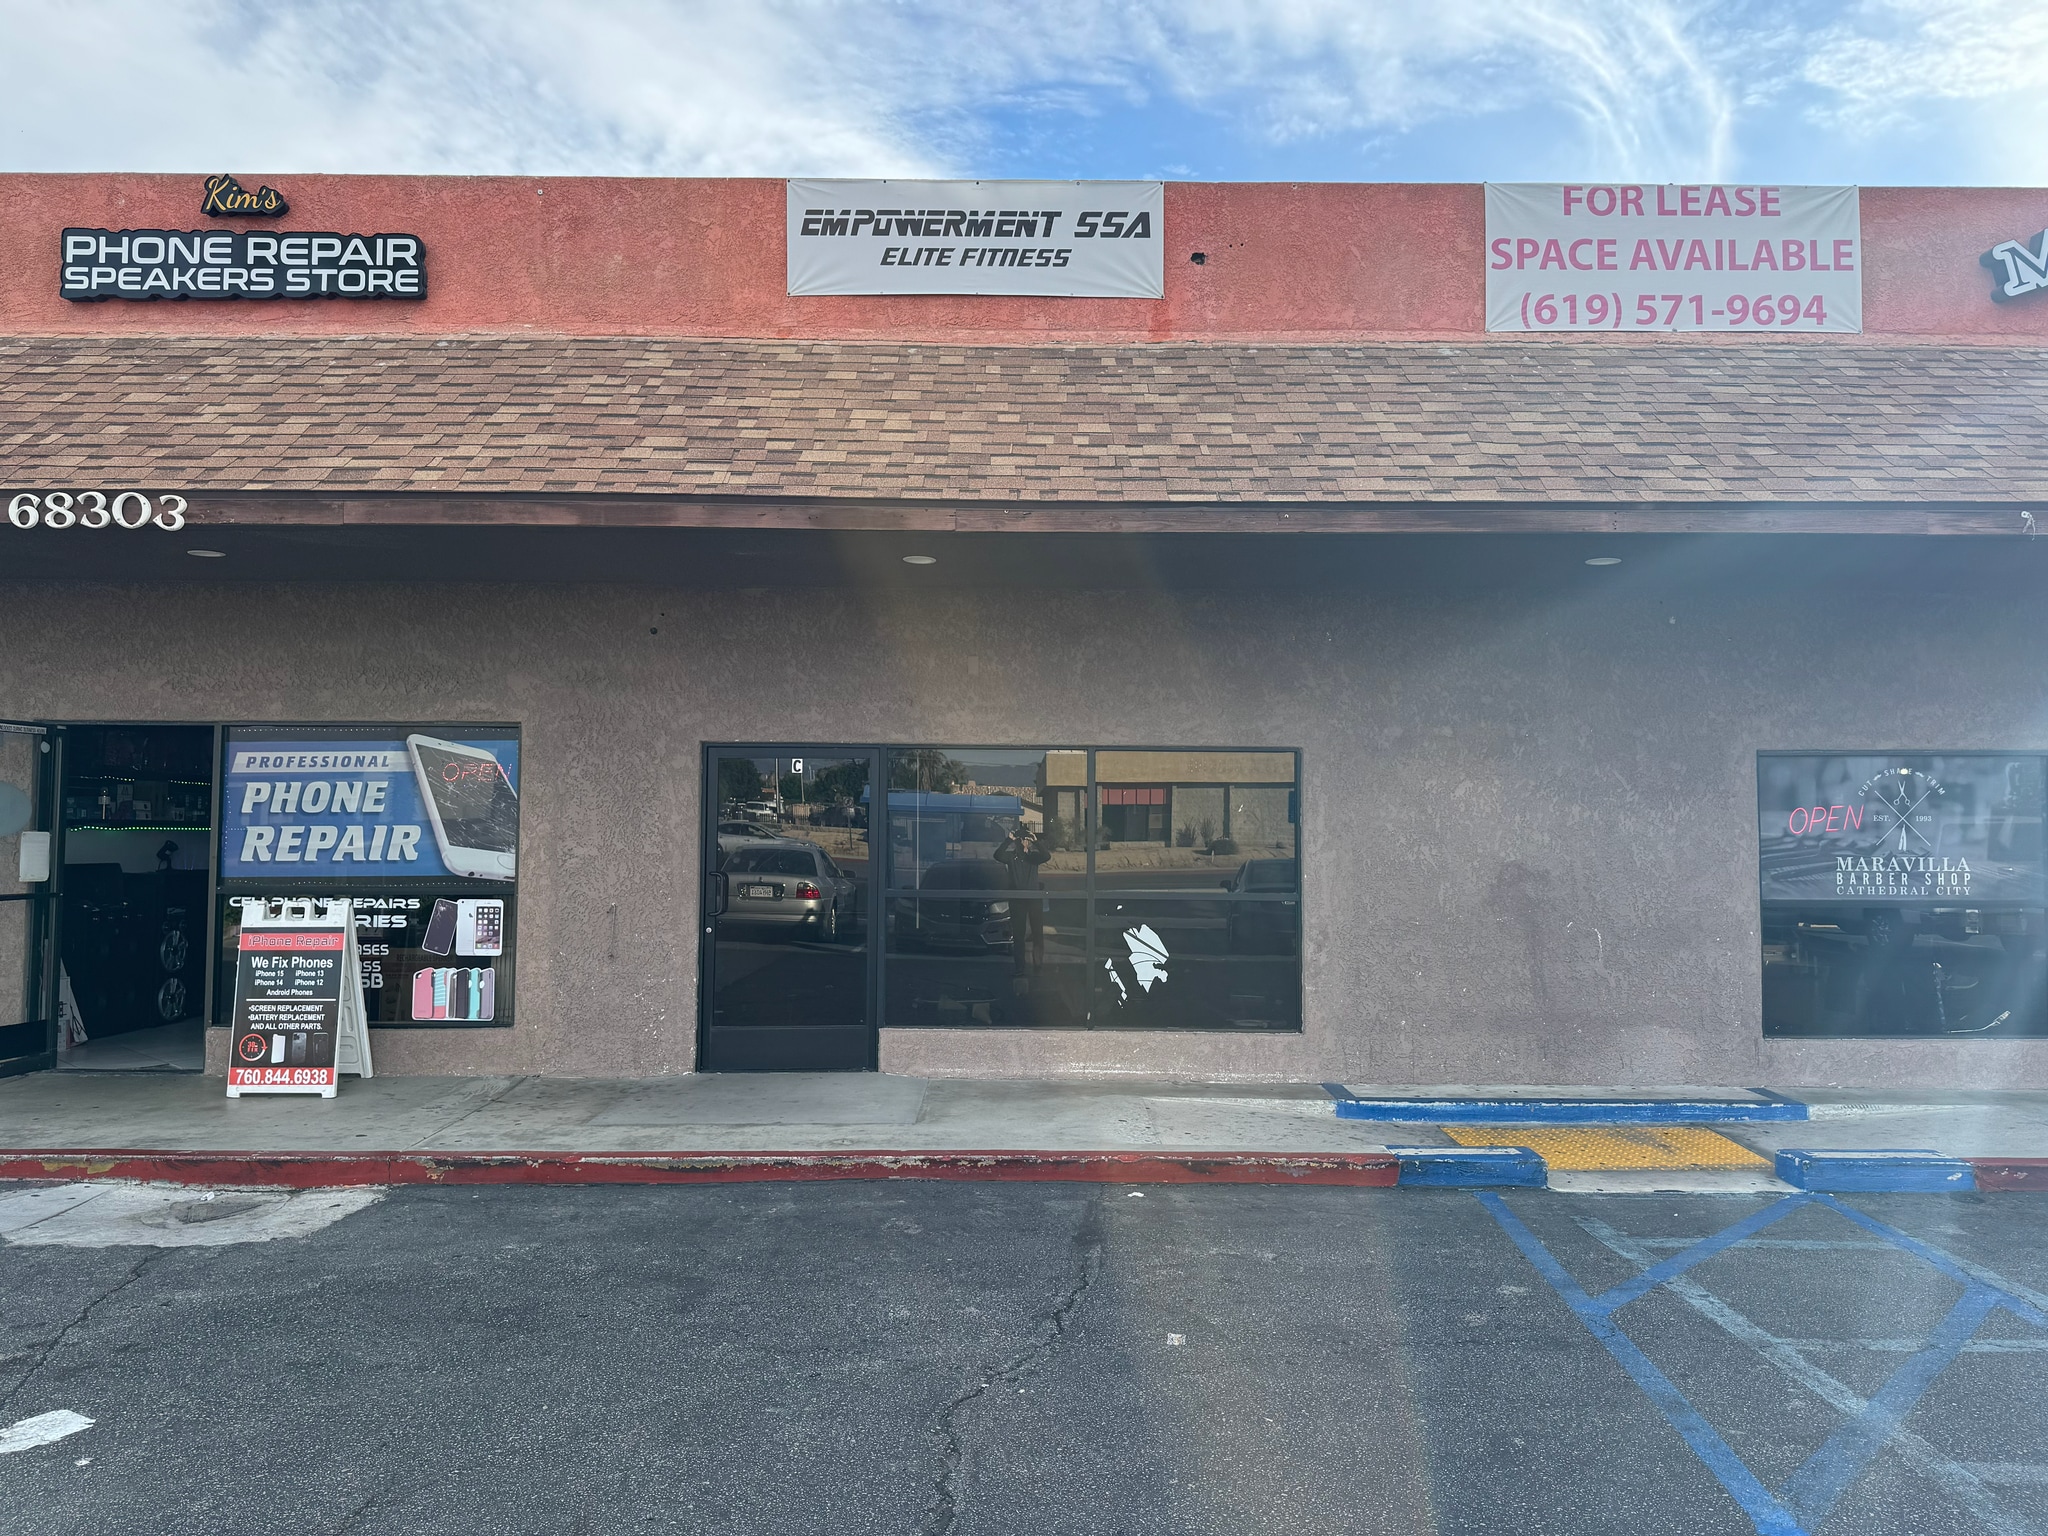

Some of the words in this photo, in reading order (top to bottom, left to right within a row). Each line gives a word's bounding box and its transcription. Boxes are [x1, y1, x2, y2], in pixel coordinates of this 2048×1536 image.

[205, 178, 281, 211] Kim's
[1563, 185, 1645, 217] FOR
[1657, 185, 1781, 217] LEASE
[800, 209, 1062, 238] EMPOWERMENT
[1073, 211, 1152, 239] SSA
[65, 235, 233, 265] PHONE
[247, 237, 417, 266] REPAIR
[880, 247, 956, 267] ELITE
[959, 247, 1073, 268] FITNESS
[1490, 238, 1618, 271] SPACE
[1630, 238, 1854, 272] AVAILABLE
[64, 267, 274, 291] SPEAKERS
[286, 269, 419, 293] STORE
[1521, 292, 1622, 329] (619)
[1635, 293, 1828, 326] 571-9694
[8, 491, 189, 531] 68303
[246, 755, 390, 769] PROFESSIONAL
[442, 762, 512, 783] OPEN
[794, 760, 801, 772] C
[1858, 780, 1873, 797] CUT
[1884, 768, 1913, 777] SHAE
[1926, 775, 1945, 795] TRIM
[241, 781, 389, 814] PHONE
[1789, 804, 1865, 835] OPEN
[240, 825, 422, 862] REPAIR
[1836, 856, 1971, 872] MARAVILLA
[1836, 872, 1908, 886] BARBER
[1924, 872, 1971, 886] SHOP
[1836, 885, 1929, 896] CATHEDRAL
[1936, 886, 1972, 896] CITY
[248, 935, 292, 947] iPhone
[296, 935, 339, 950] Repair
[251, 956, 269, 969] We
[271, 956, 288, 969] Fix
[291, 956, 334, 969] Phones
[266, 988, 290, 996] Android
[277, 1004, 323, 1012] REPLACEMENT
[279, 1013, 325, 1021] REPLACEMENT
[250, 1022, 264, 1030] AND
[265, 1022, 277, 1030] ALL
[278, 1022, 299, 1030] OTHER
[300, 1022, 323, 1030] PARTS.
[236, 1069, 328, 1084] 760.844.6938
